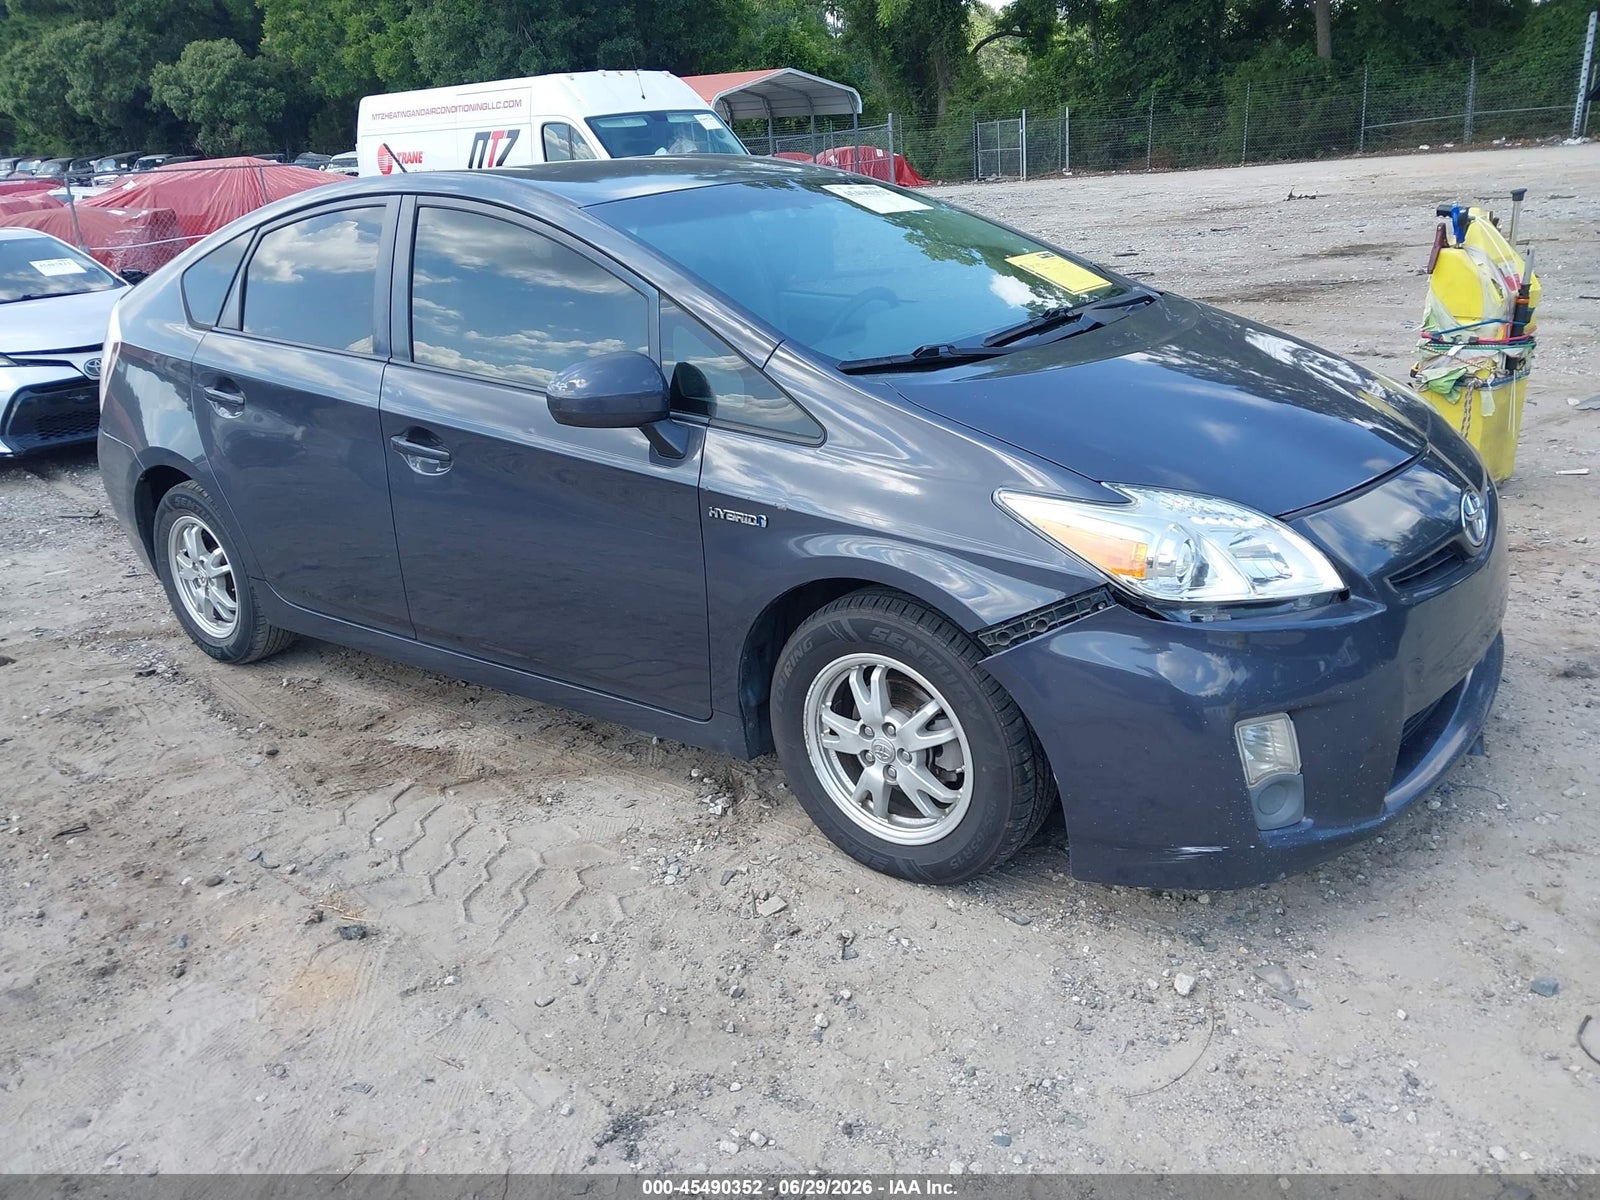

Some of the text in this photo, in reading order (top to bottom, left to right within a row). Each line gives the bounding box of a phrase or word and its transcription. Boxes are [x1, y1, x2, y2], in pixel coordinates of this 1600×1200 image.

[371, 99, 523, 120] MTZHEATINGANDAIRCONDITIONINGLLC.COM
[397, 151, 424, 164] TRANE
[709, 506, 757, 526] HYBRID
